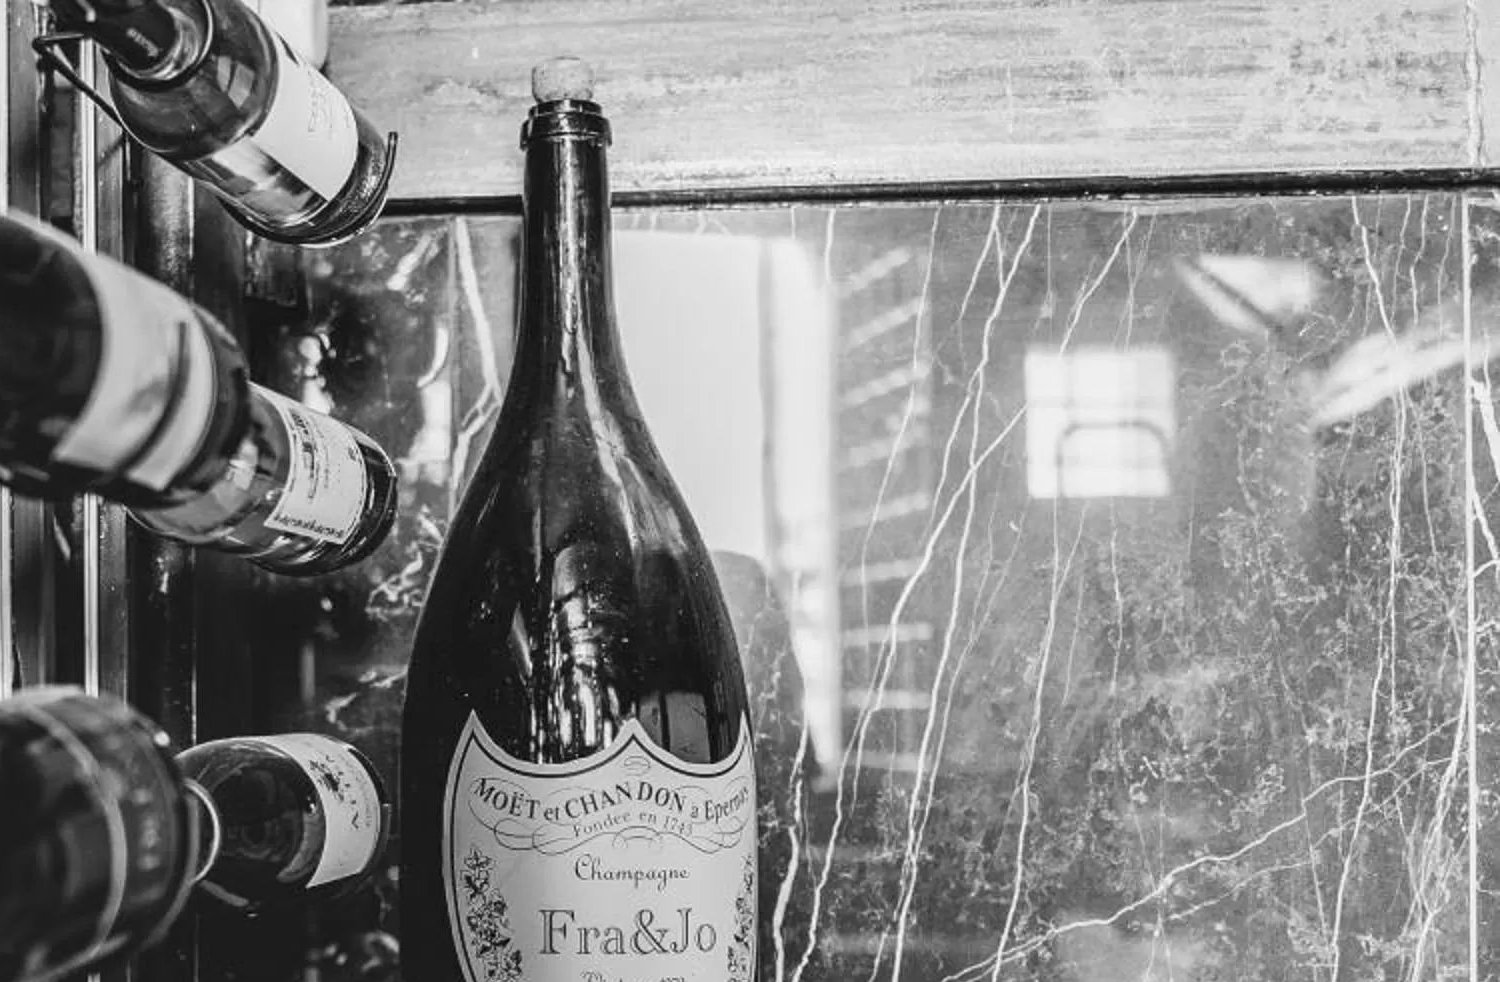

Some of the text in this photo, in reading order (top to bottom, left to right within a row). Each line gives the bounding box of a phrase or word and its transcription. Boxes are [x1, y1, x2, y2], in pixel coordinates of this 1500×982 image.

[474, 778, 541, 819] MOËT
[543, 805, 560, 821] et
[565, 781, 687, 819] CHANDON
[639, 811, 657, 825] en
[574, 853, 690, 892] Champagne
[538, 907, 717, 955] Fra&Jo
